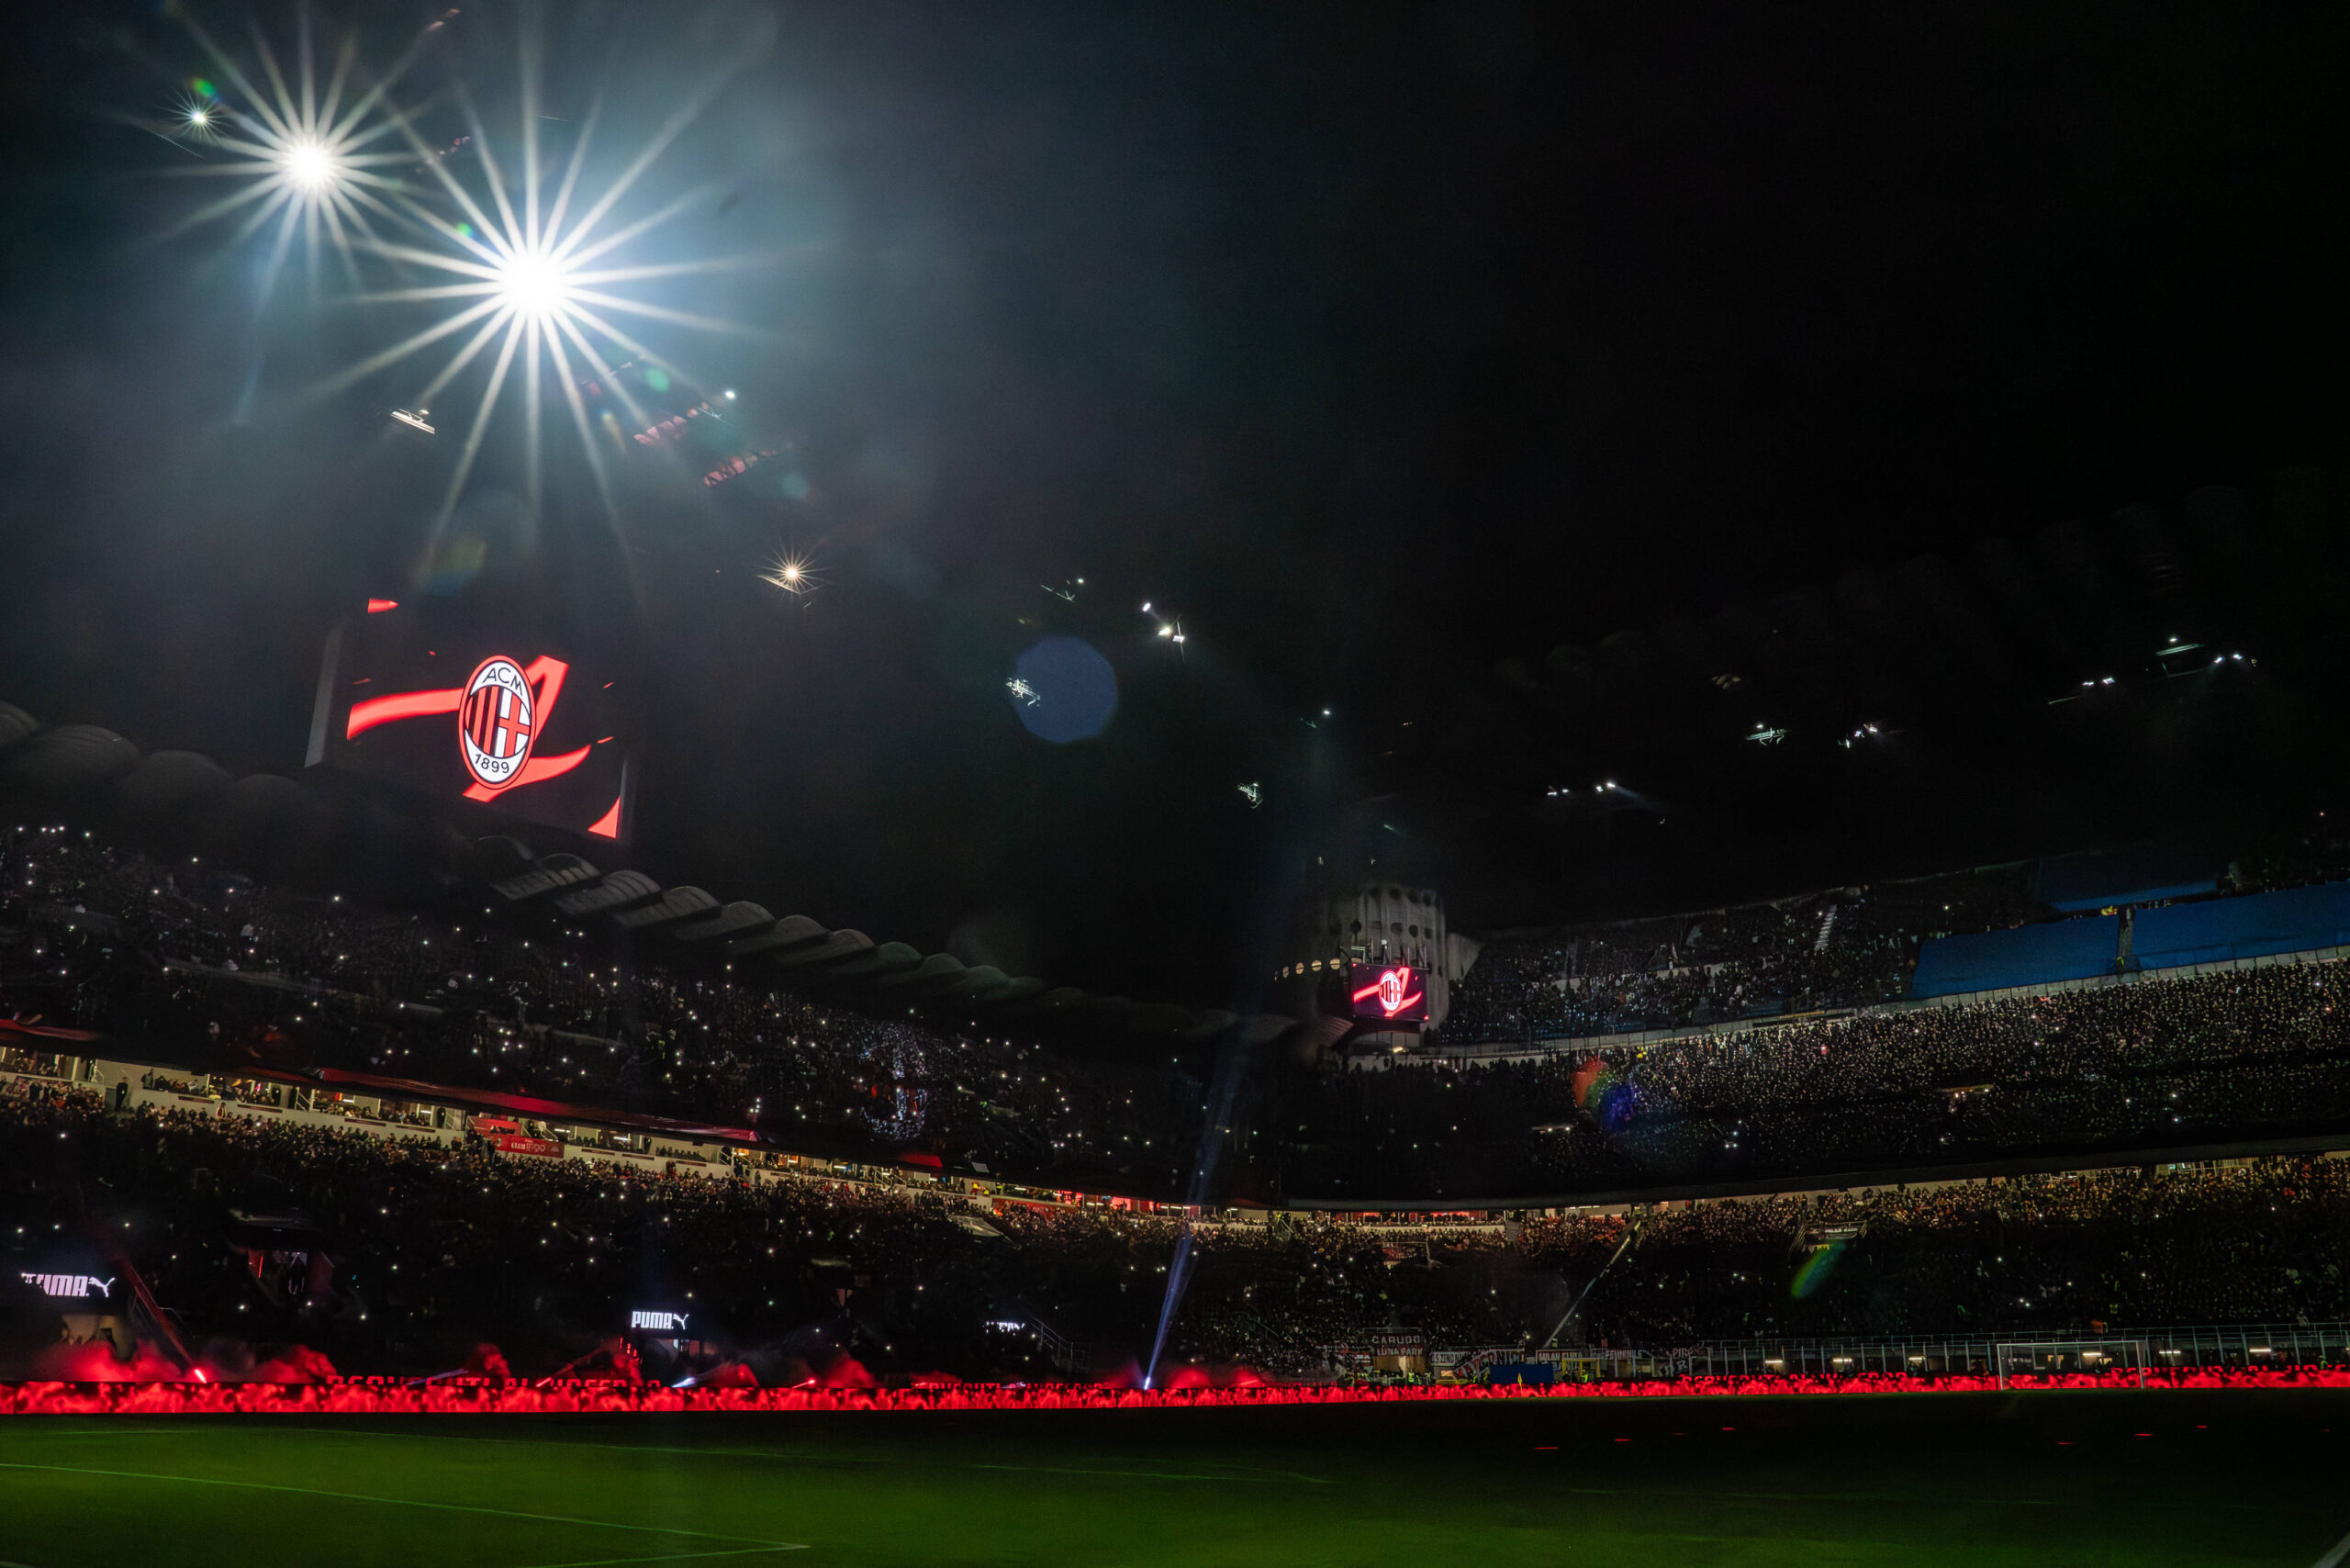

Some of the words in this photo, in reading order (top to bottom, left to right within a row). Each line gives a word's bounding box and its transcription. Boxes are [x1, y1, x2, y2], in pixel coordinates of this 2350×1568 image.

[482, 667, 523, 697] ACM
[475, 753, 509, 774] 1899
[631, 1311, 673, 1329] PUMA
